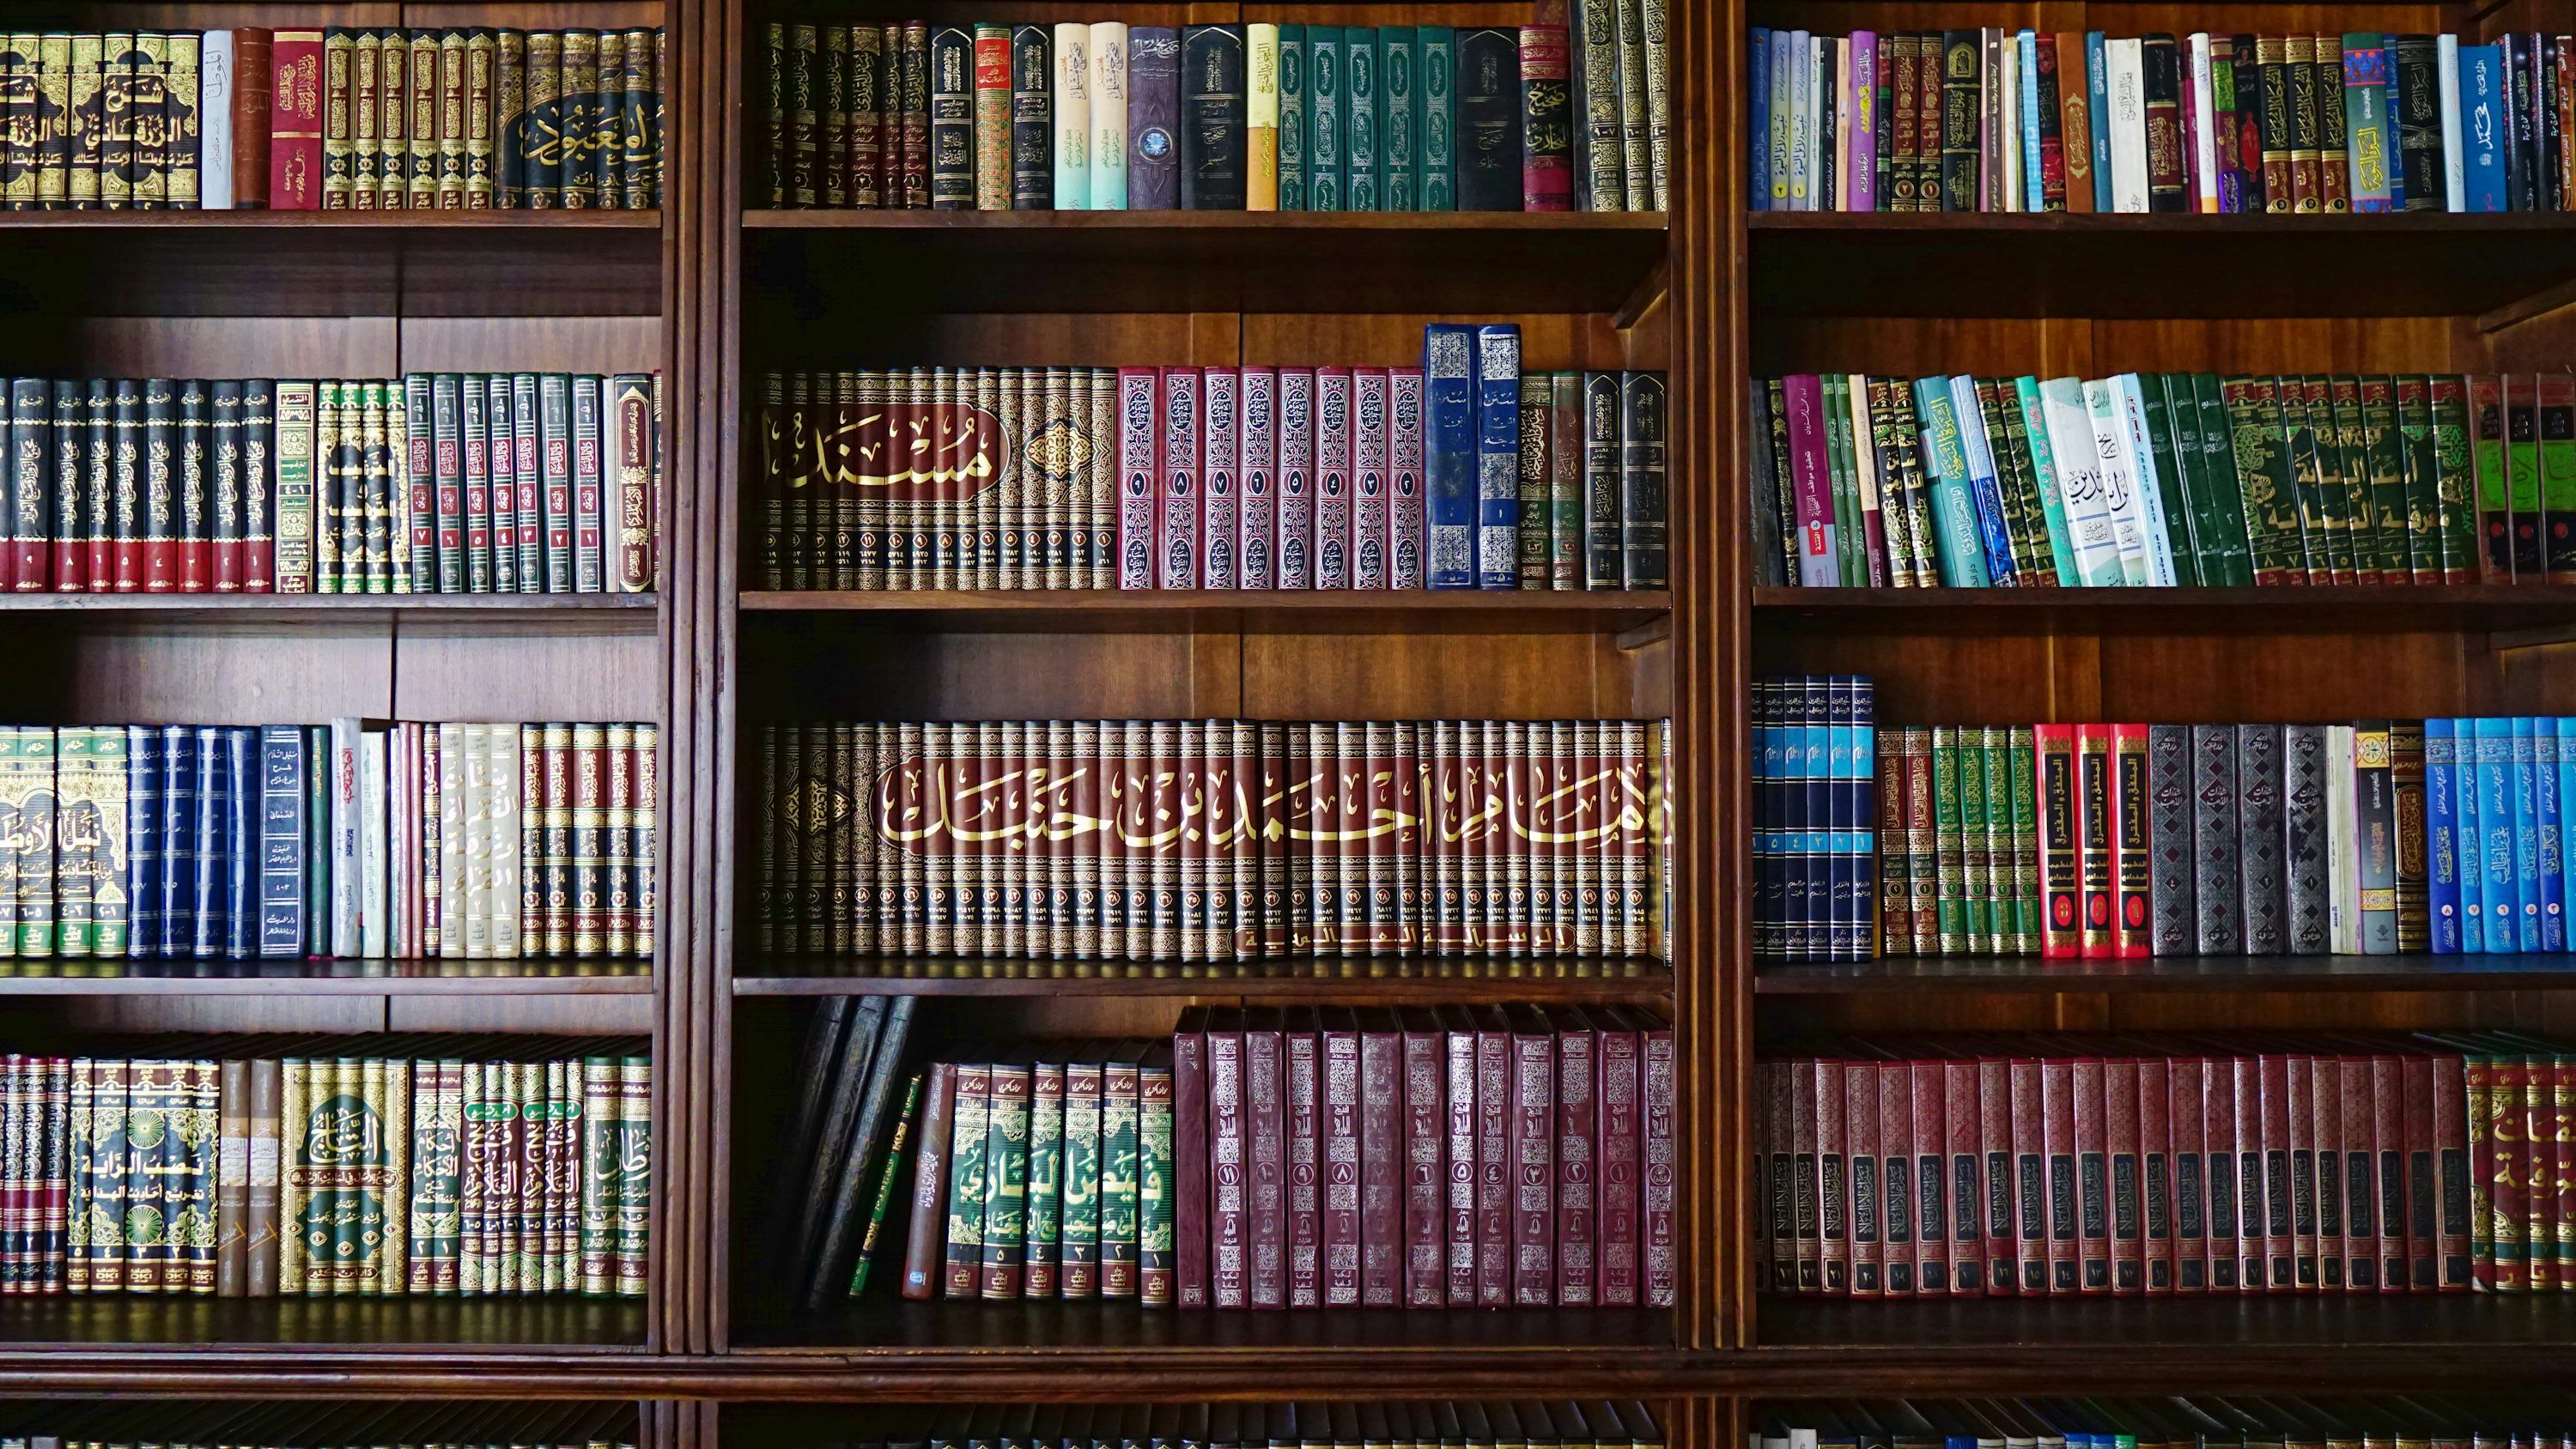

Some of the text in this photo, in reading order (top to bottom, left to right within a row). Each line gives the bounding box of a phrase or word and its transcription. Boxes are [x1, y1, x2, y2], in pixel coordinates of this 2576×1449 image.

[105, 77, 165, 112] شرح
[0, 113, 51, 148] الزرق
[85, 113, 181, 149] الزرقاني
[787, 409, 993, 488] مسند
[1134, 480, 1140, 489] ٩
[1217, 479, 1224, 488] ٧
[1291, 478, 1299, 488] ٥
[1367, 479, 1375, 489] ٣
[883, 763, 1114, 851] حنبل
[1219, 1105, 1235, 1116] فتح
[81, 1149, 141, 1179] الراية
[143, 1153, 204, 1180] نصب
[959, 1148, 1163, 1204] فيض الباري
[1223, 1167, 1234, 1181] ١١
[1299, 1167, 1307, 1182] ٩
[1337, 1168, 1349, 1181] ٨
[1458, 1166, 1467, 1178] ٥
[1530, 1167, 1540, 1183] ٣
[1571, 1164, 1580, 1179] ٢
[80, 1183, 204, 1203] تخريج أحاديث الهداية
[996, 1252, 1005, 1261] ٥
[1036, 1247, 1044, 1260] ٤
[1075, 1247, 1084, 1258] ٣
[1115, 1246, 1122, 1258] ٢
[1156, 1253, 1160, 1266] ١
